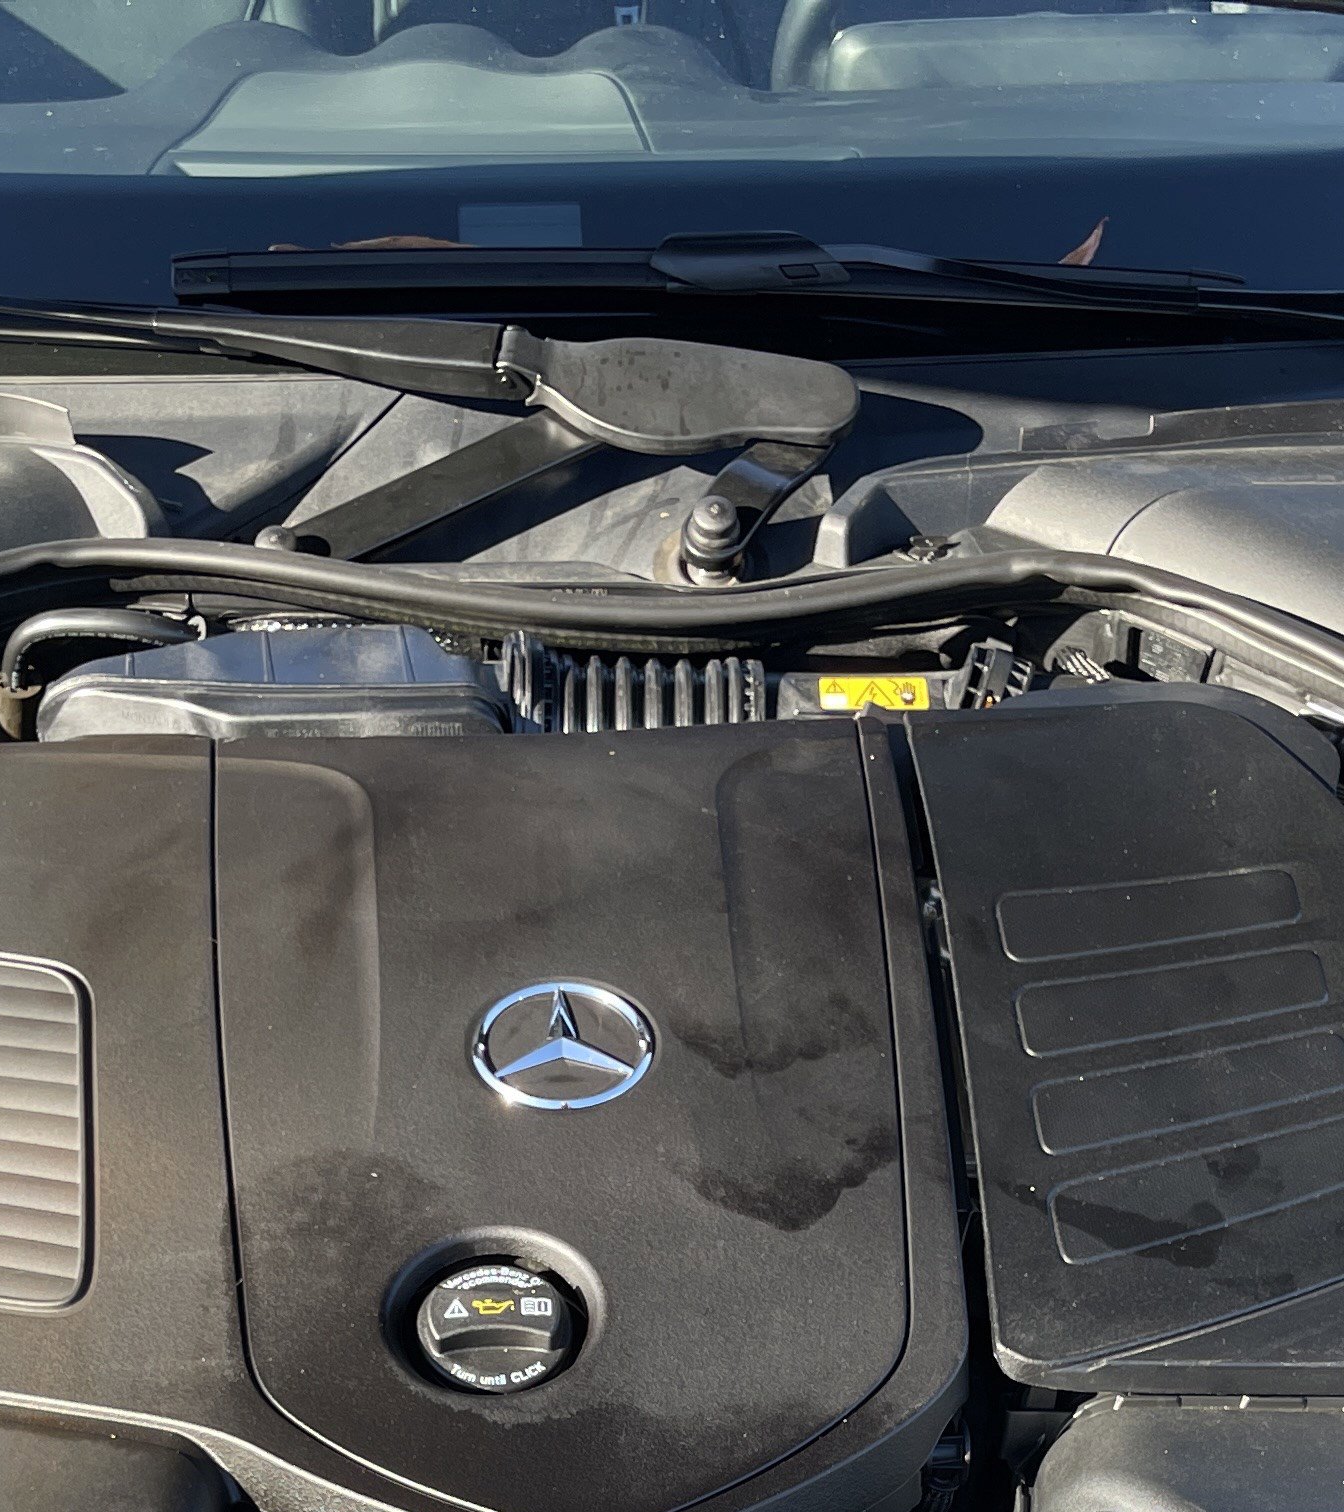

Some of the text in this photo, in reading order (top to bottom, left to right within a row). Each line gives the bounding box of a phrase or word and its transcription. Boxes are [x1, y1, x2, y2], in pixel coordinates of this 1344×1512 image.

[449, 1361, 547, 1386] Turn until CLICK
